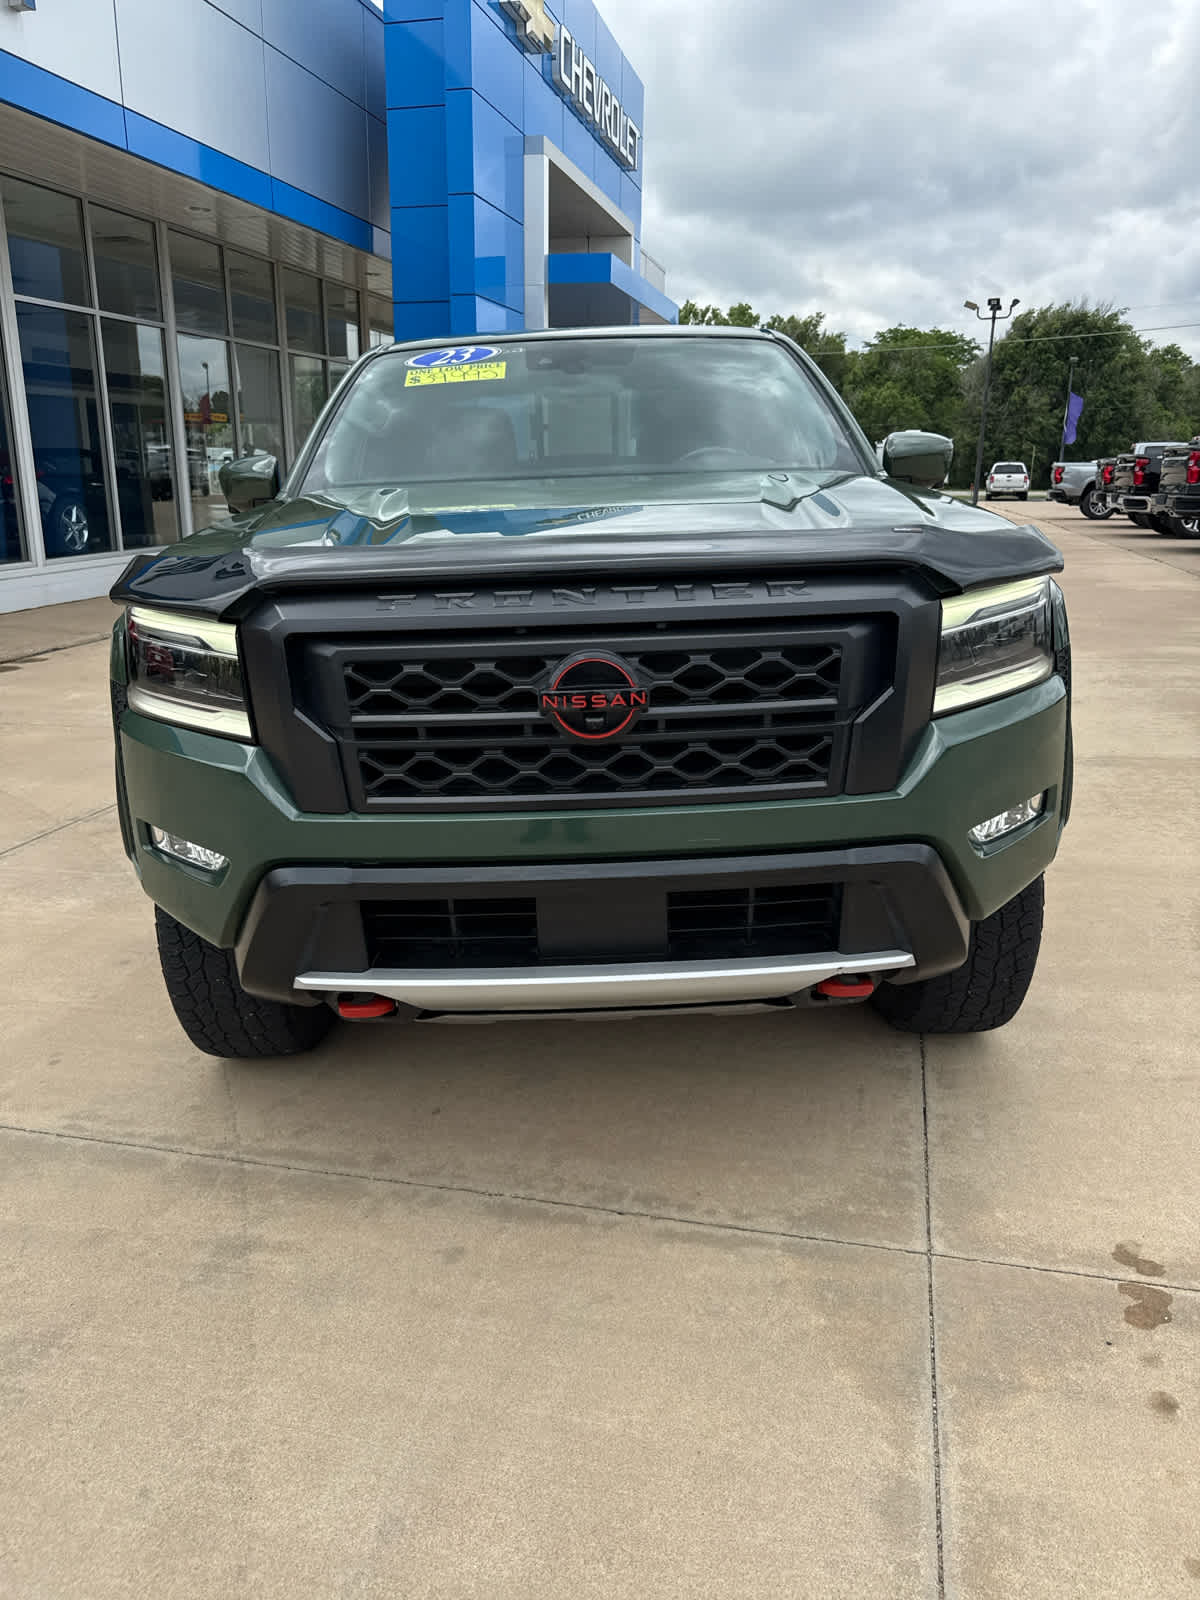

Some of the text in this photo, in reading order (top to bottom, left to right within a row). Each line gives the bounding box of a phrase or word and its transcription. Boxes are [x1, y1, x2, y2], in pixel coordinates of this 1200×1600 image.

[559, 24, 640, 170] CHEVROLET
[430, 346, 477, 366] 23
[409, 362, 503, 376] ONE LOW PRICE
[376, 579, 813, 612] FRONTIER
[542, 690, 647, 710] NISSAN
